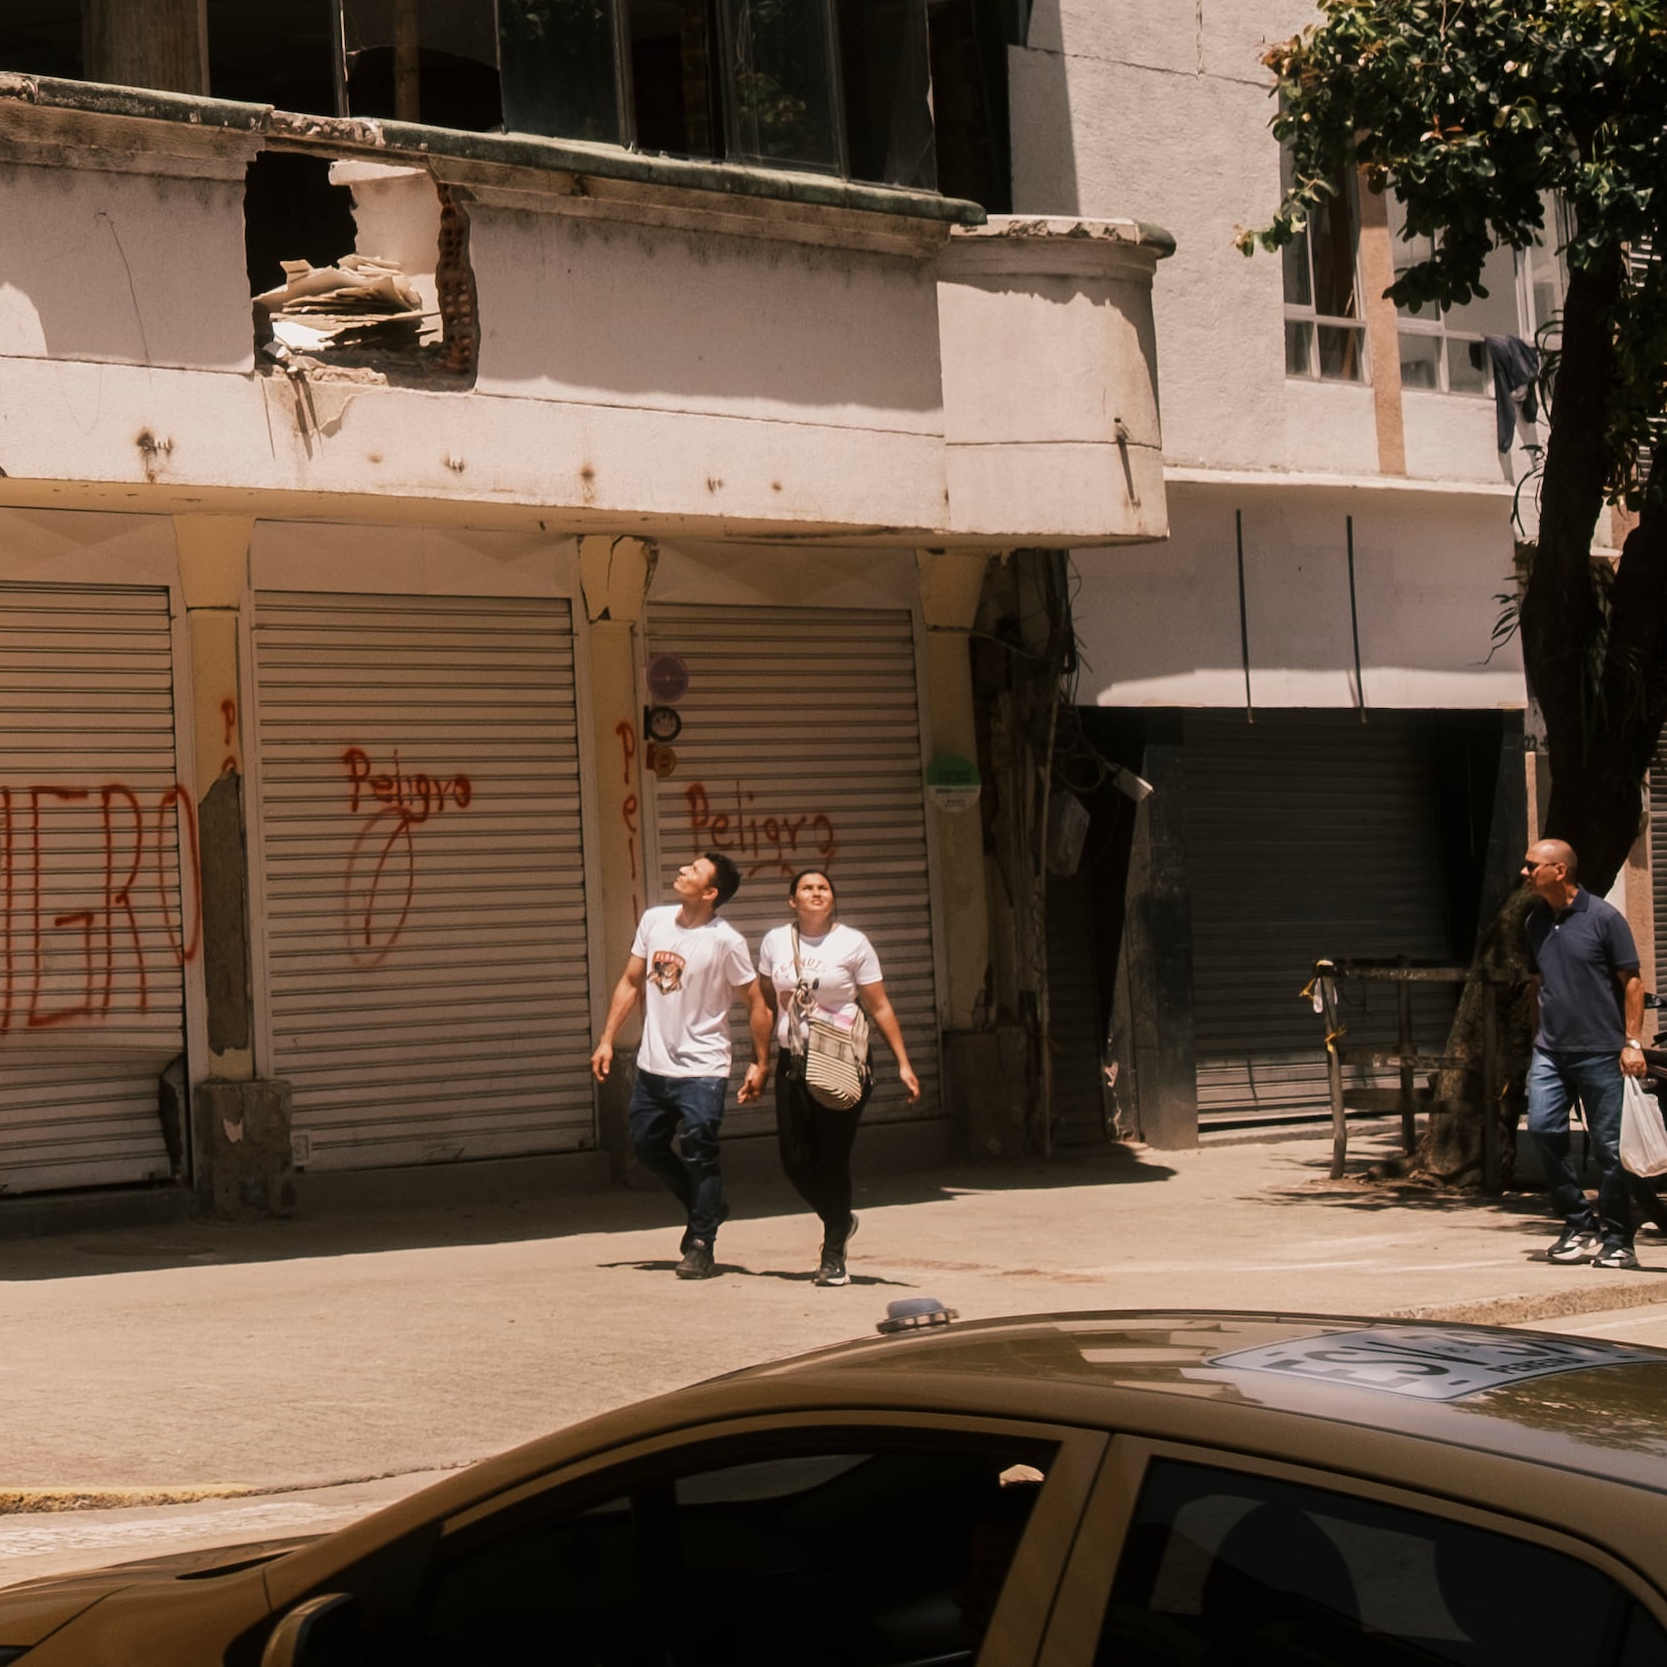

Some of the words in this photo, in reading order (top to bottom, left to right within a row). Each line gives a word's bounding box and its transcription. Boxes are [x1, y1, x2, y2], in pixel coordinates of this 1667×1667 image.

[339, 747, 472, 823] Peligro
[685, 780, 836, 876] Peligro
[1485, 1356, 1596, 1375] PEREIRA
